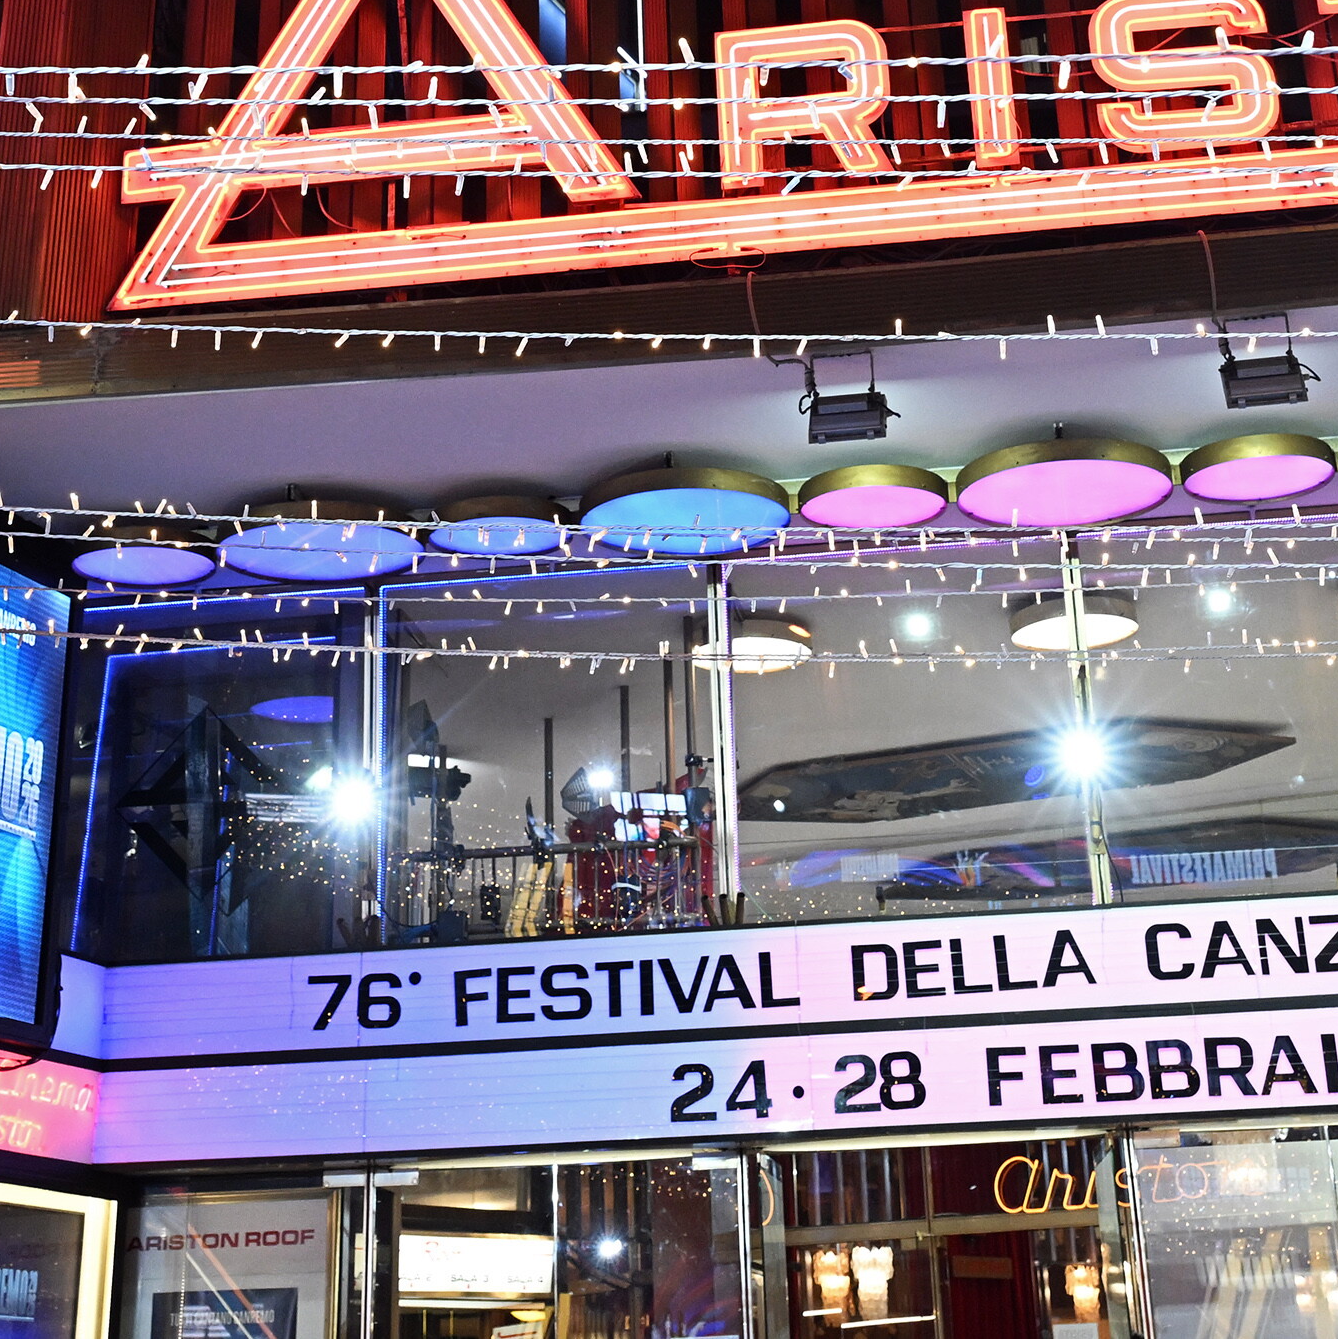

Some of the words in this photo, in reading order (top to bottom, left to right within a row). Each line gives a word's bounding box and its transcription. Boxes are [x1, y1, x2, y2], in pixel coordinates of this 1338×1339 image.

[455, 952, 801, 1027] FESTIVAL
[850, 929, 1098, 1002] DELLA
[127, 1232, 240, 1253] ARISTON
[244, 1229, 315, 1248] ROOF
